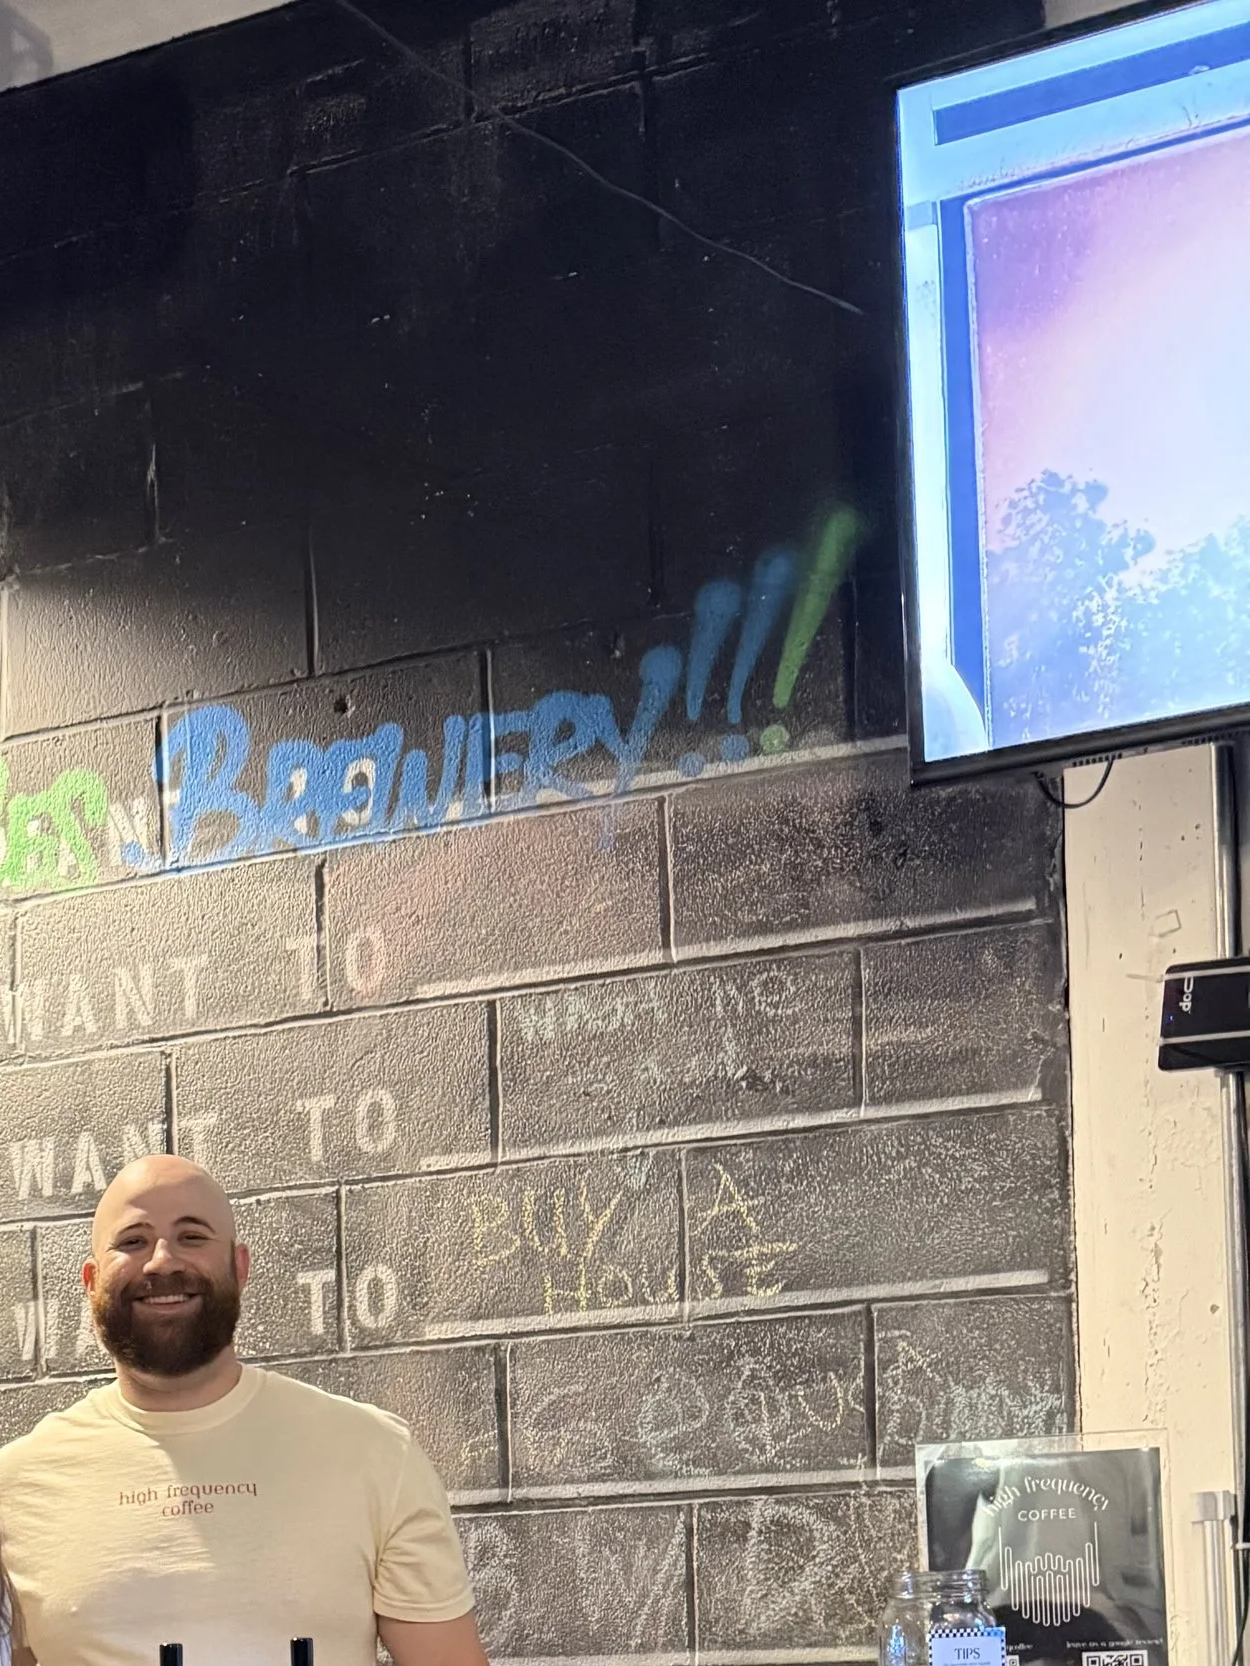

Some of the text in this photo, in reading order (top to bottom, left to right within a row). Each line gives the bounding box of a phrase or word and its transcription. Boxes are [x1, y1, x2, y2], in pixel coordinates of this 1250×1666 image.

[1, 955, 208, 1046] WANT
[285, 926, 387, 1001] TO
[295, 1087, 398, 1163] TO
[469, 1181, 621, 1271] BUY
[297, 1262, 398, 1336] TO
[118, 1482, 257, 1506] high frequency
[162, 1500, 214, 1517] coffee
[981, 1485, 1021, 1517] high
[1017, 1508, 1077, 1522] COFFEE
[954, 1647, 981, 1660] TIPS
